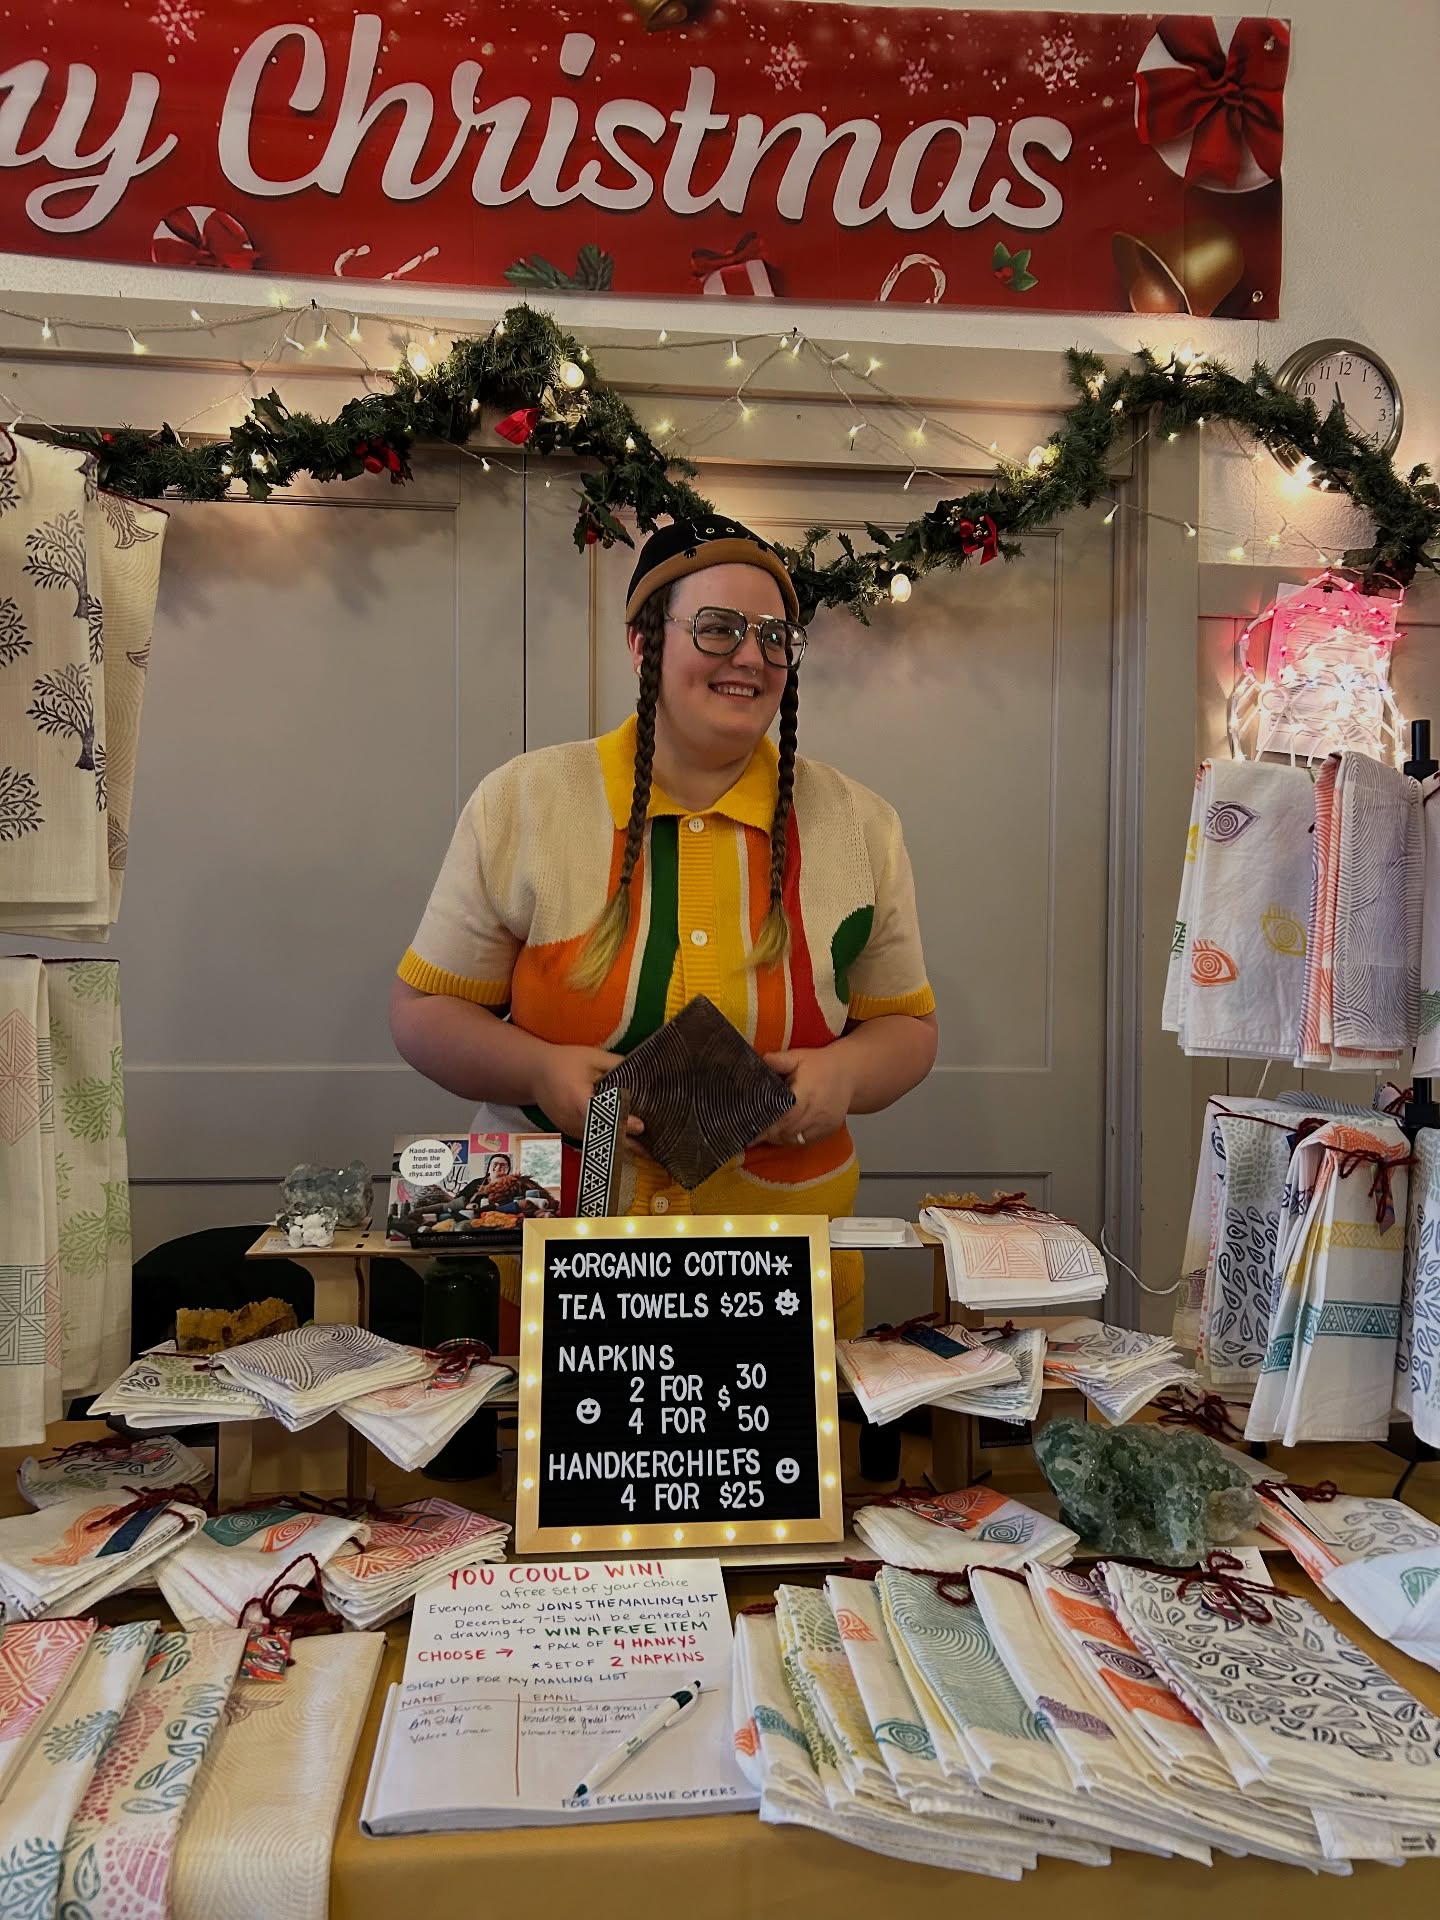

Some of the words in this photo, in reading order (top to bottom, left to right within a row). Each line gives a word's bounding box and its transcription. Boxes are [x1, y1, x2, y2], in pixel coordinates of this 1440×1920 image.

[217, 14, 1073, 230] Christmas
[1319, 365, 1331, 380] 11
[1339, 361, 1352, 376] 12
[1362, 368, 1368, 382] 1
[1304, 382, 1316, 395] 10
[1374, 386, 1382, 399] 2
[1378, 408, 1386, 421] 3
[1370, 431, 1380, 444] 4
[558, 1292, 605, 1320] TEA
[617, 1292, 709, 1319] TOWELS
[720, 1291, 764, 1318] $25
[558, 1344, 675, 1372] NAPKINS
[629, 1377, 645, 1403] 2
[660, 1375, 703, 1402] FOR
[736, 1363, 767, 1390] 30
[717, 1385, 731, 1411] $
[628, 1408, 644, 1435] 4
[661, 1407, 706, 1434] FOR
[737, 1405, 769, 1432] 50
[549, 1448, 760, 1481] HANDKERCHIEFS
[620, 1484, 636, 1512] 4
[655, 1482, 700, 1511] FOR
[719, 1480, 765, 1509] $25
[448, 1568, 496, 1590] YOU
[509, 1566, 590, 1584] COULD
[604, 1561, 665, 1579] WIN!
[500, 1590, 511, 1598] a
[514, 1587, 546, 1599] free
[552, 1585, 577, 1596] set
[582, 1584, 598, 1593] of
[603, 1582, 638, 1595] your
[643, 1579, 689, 1589] choice
[429, 1603, 494, 1615] Everyone
[501, 1602, 531, 1610] who
[537, 1601, 583, 1612] JOINS
[688, 1593, 719, 1603] LIST
[455, 1617, 525, 1629] December
[533, 1615, 566, 1624] 7-15
[575, 1613, 601, 1622] will
[611, 1612, 630, 1621] be
[639, 1610, 690, 1620] entered
[698, 1610, 711, 1618] in
[434, 1633, 443, 1641] a
[450, 1628, 511, 1640] drawing
[517, 1627, 536, 1635] to
[545, 1626, 581, 1637] WIN
[587, 1626, 601, 1636] A
[602, 1623, 657, 1635] FREE
[664, 1620, 709, 1632] ITEM
[418, 1649, 487, 1662] CHOOSE
[547, 1641, 580, 1651] PACK
[587, 1640, 604, 1648] OF
[613, 1638, 625, 1650] 4
[632, 1634, 697, 1648] HANKYS
[545, 1661, 574, 1670] SET
[575, 1659, 596, 1667] OF
[610, 1656, 624, 1667] 2
[631, 1651, 705, 1665] NAPKINS
[406, 1678, 446, 1691] SIGN
[450, 1676, 470, 1684] UP
[476, 1675, 501, 1684] FOR
[534, 1675, 593, 1685] MAILING
[599, 1672, 629, 1681] LIST
[401, 1693, 447, 1708] NAME
[533, 1694, 579, 1702] EMAIL
[561, 1798, 592, 1808] FOR
[596, 1790, 677, 1805] EXCLUSIVE
[681, 1786, 738, 1799] OFFERS
